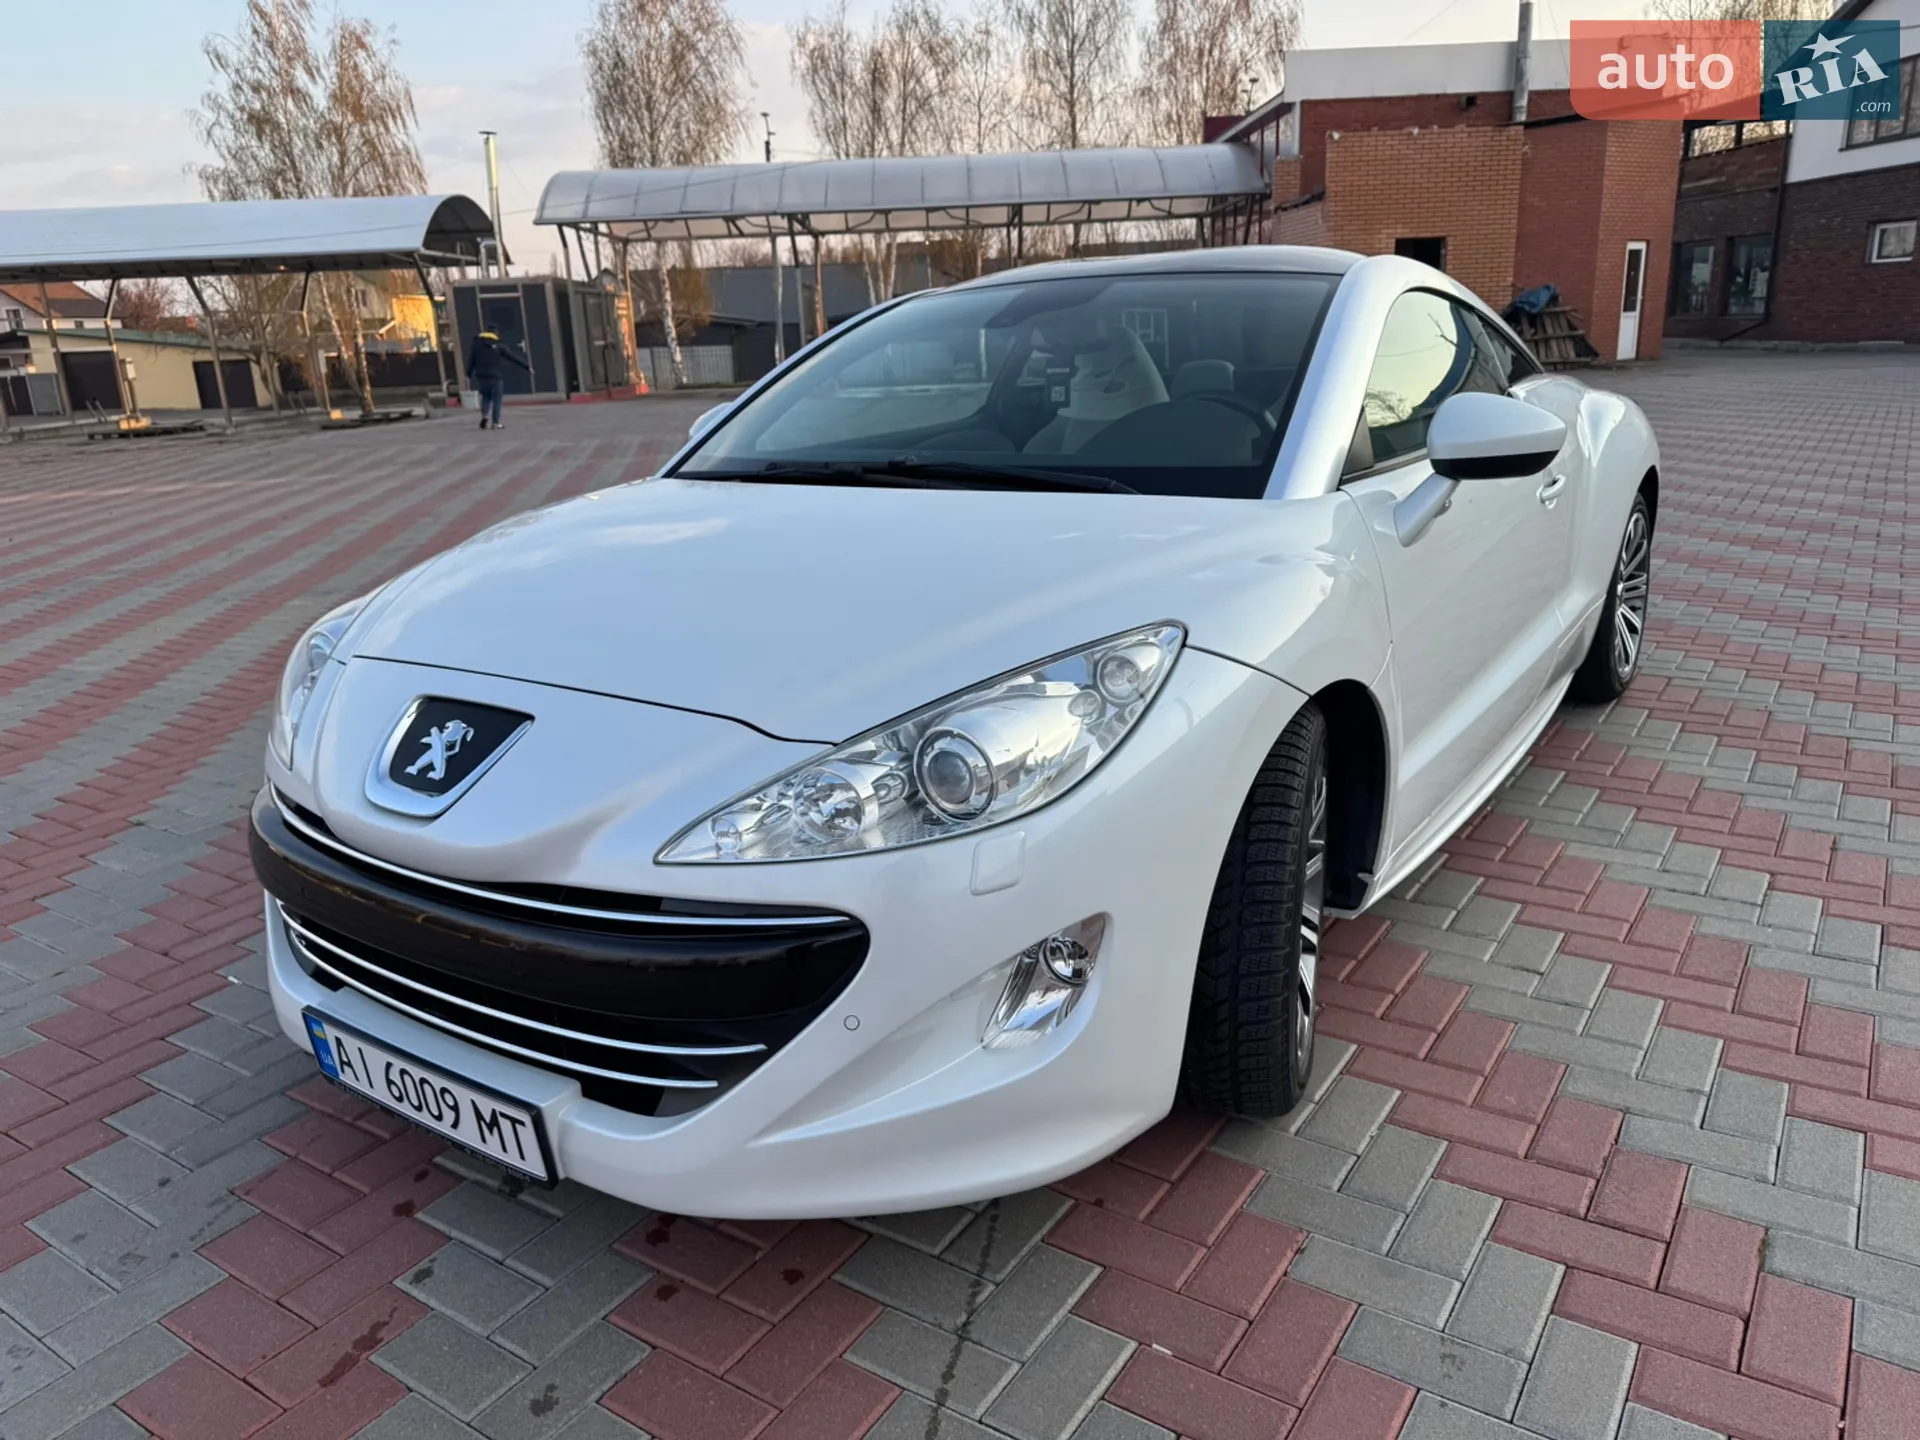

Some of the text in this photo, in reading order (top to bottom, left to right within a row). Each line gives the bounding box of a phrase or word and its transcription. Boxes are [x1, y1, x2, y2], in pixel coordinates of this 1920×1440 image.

[335, 1036, 374, 1089] AI
[385, 1061, 460, 1130] 6009
[470, 1098, 526, 1161] MT
